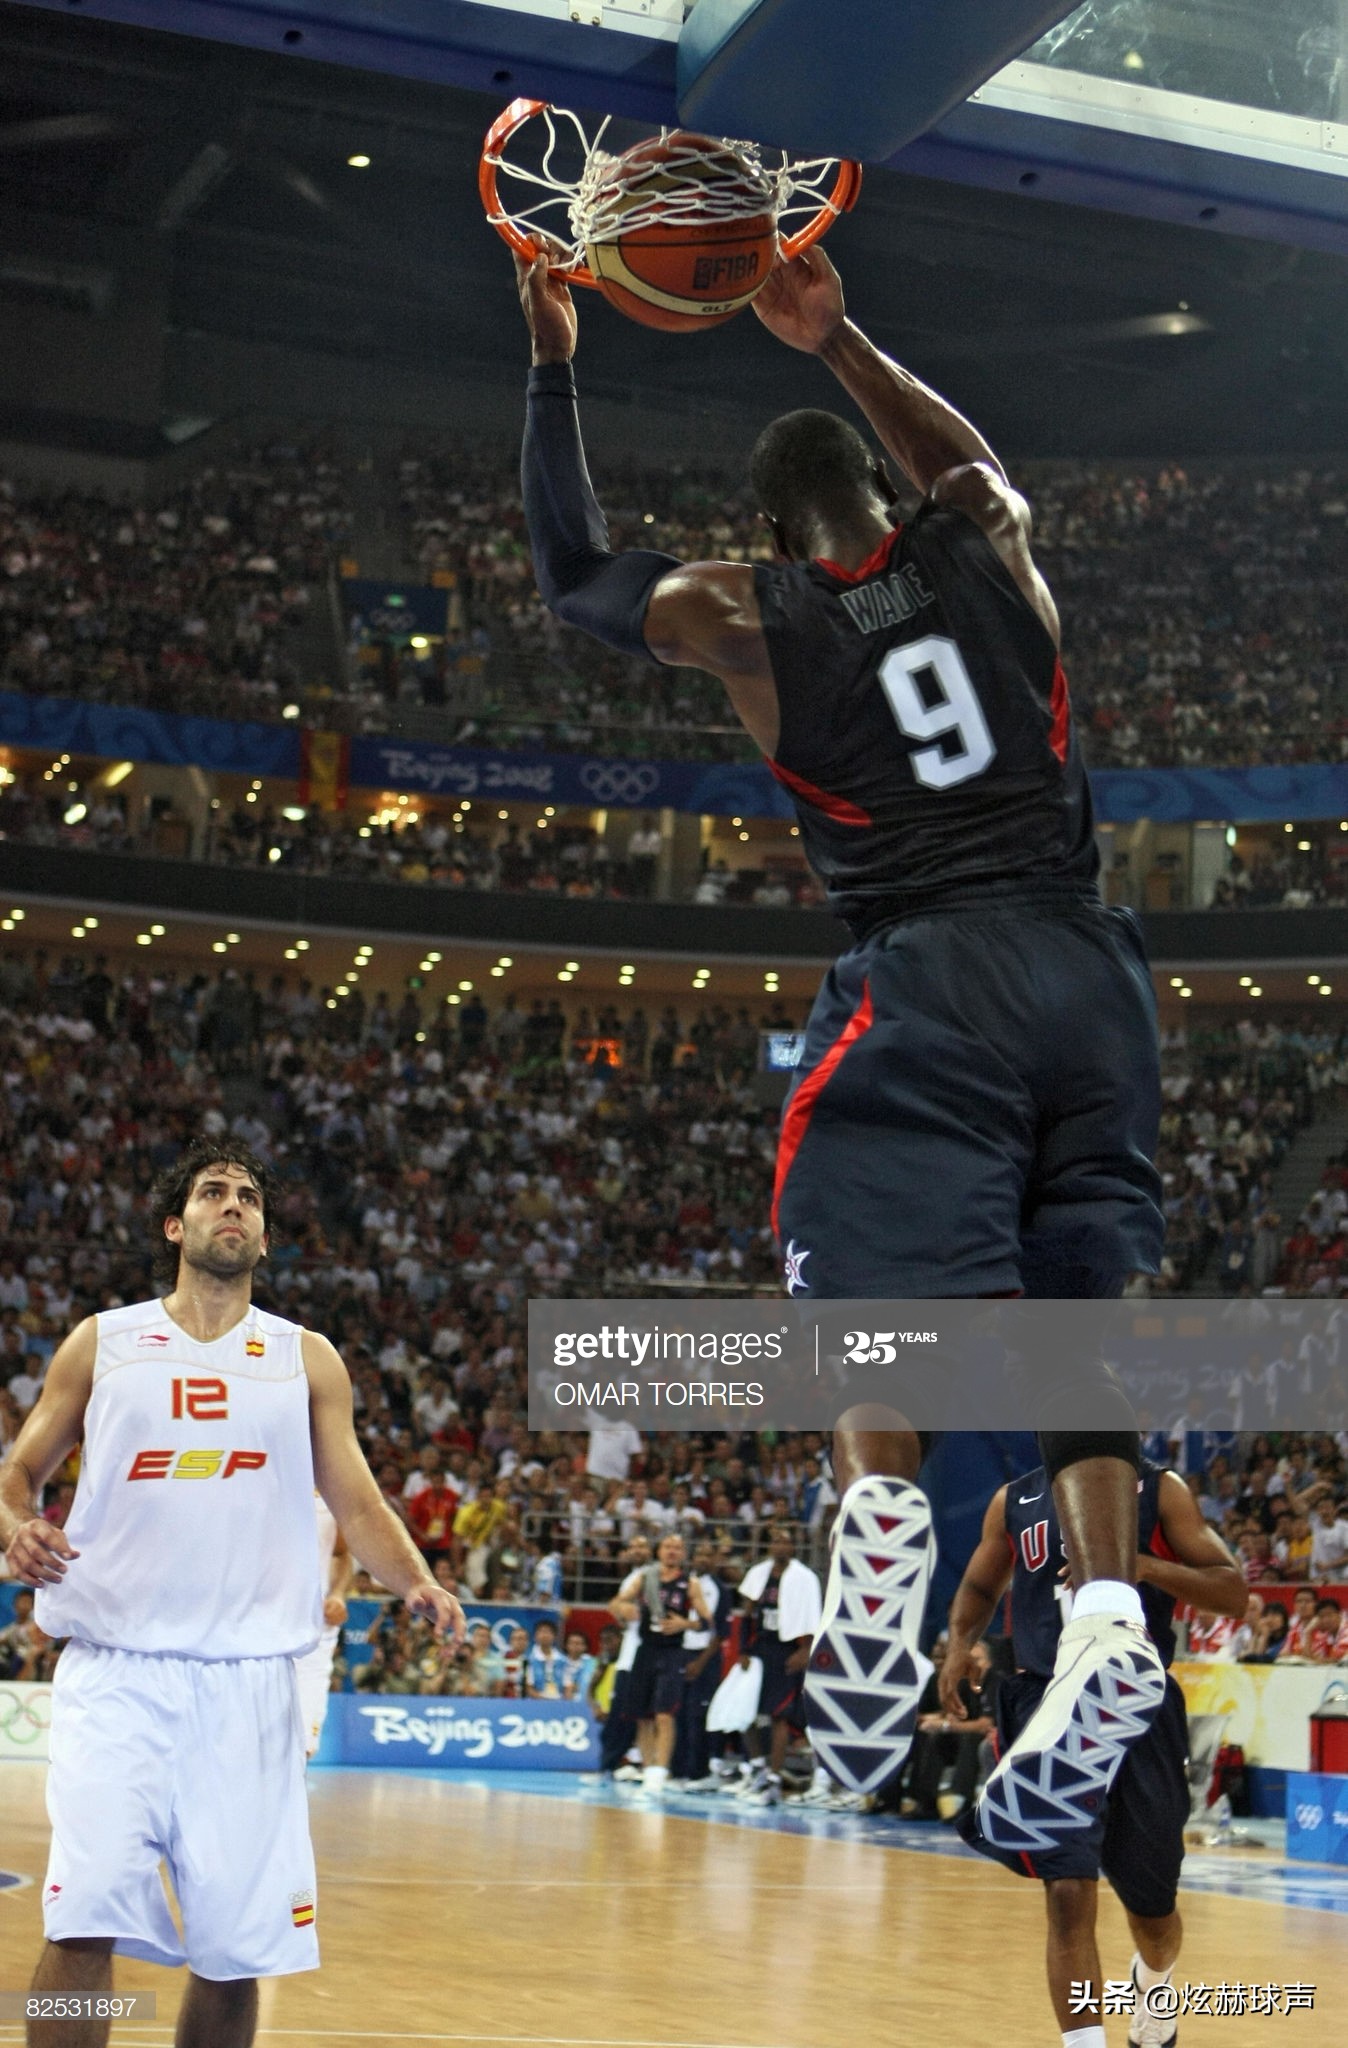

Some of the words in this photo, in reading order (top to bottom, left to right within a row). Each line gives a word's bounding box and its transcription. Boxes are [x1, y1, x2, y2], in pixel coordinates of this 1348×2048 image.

[711, 251, 759, 283] FIBA
[839, 563, 937, 634] WADE
[877, 634, 998, 791] 9
[379, 749, 479, 793] Beijing
[171, 1378, 229, 1421] 12
[127, 1450, 268, 1481] ESP
[358, 1706, 495, 1758] Beijing
[497, 1714, 591, 1752] 2008
